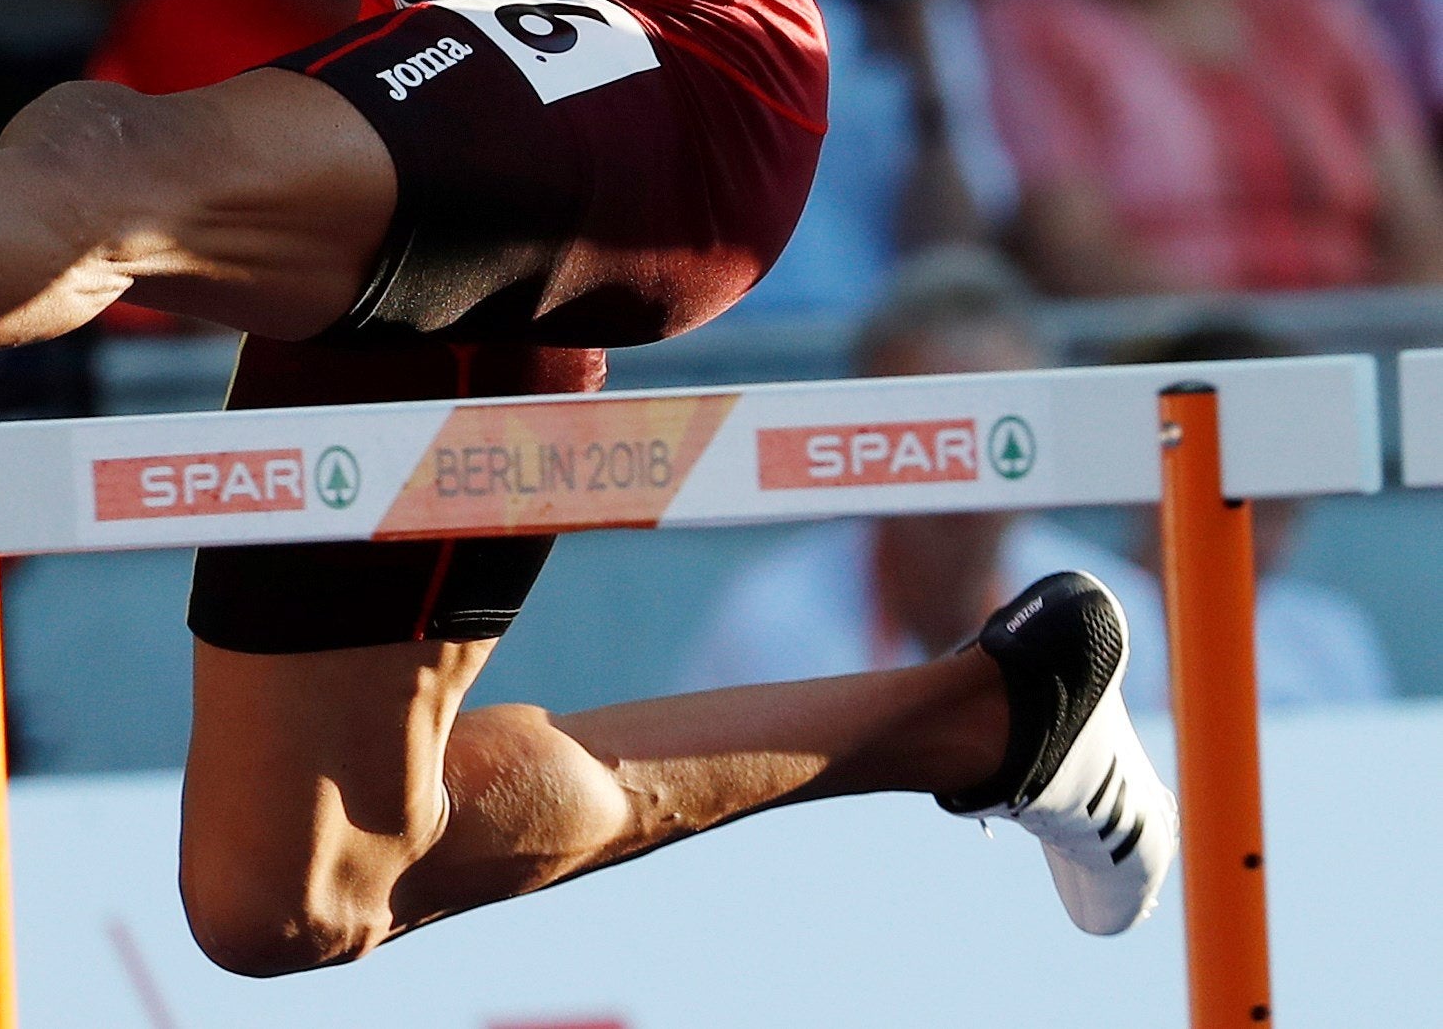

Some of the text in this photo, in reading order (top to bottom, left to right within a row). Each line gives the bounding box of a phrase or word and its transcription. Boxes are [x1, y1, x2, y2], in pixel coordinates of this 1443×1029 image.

[376, 36, 473, 101] Joma
[435, 438, 671, 497] BERLIN 2018
[807, 428, 975, 478] SPAR
[140, 458, 303, 508] SPAR
